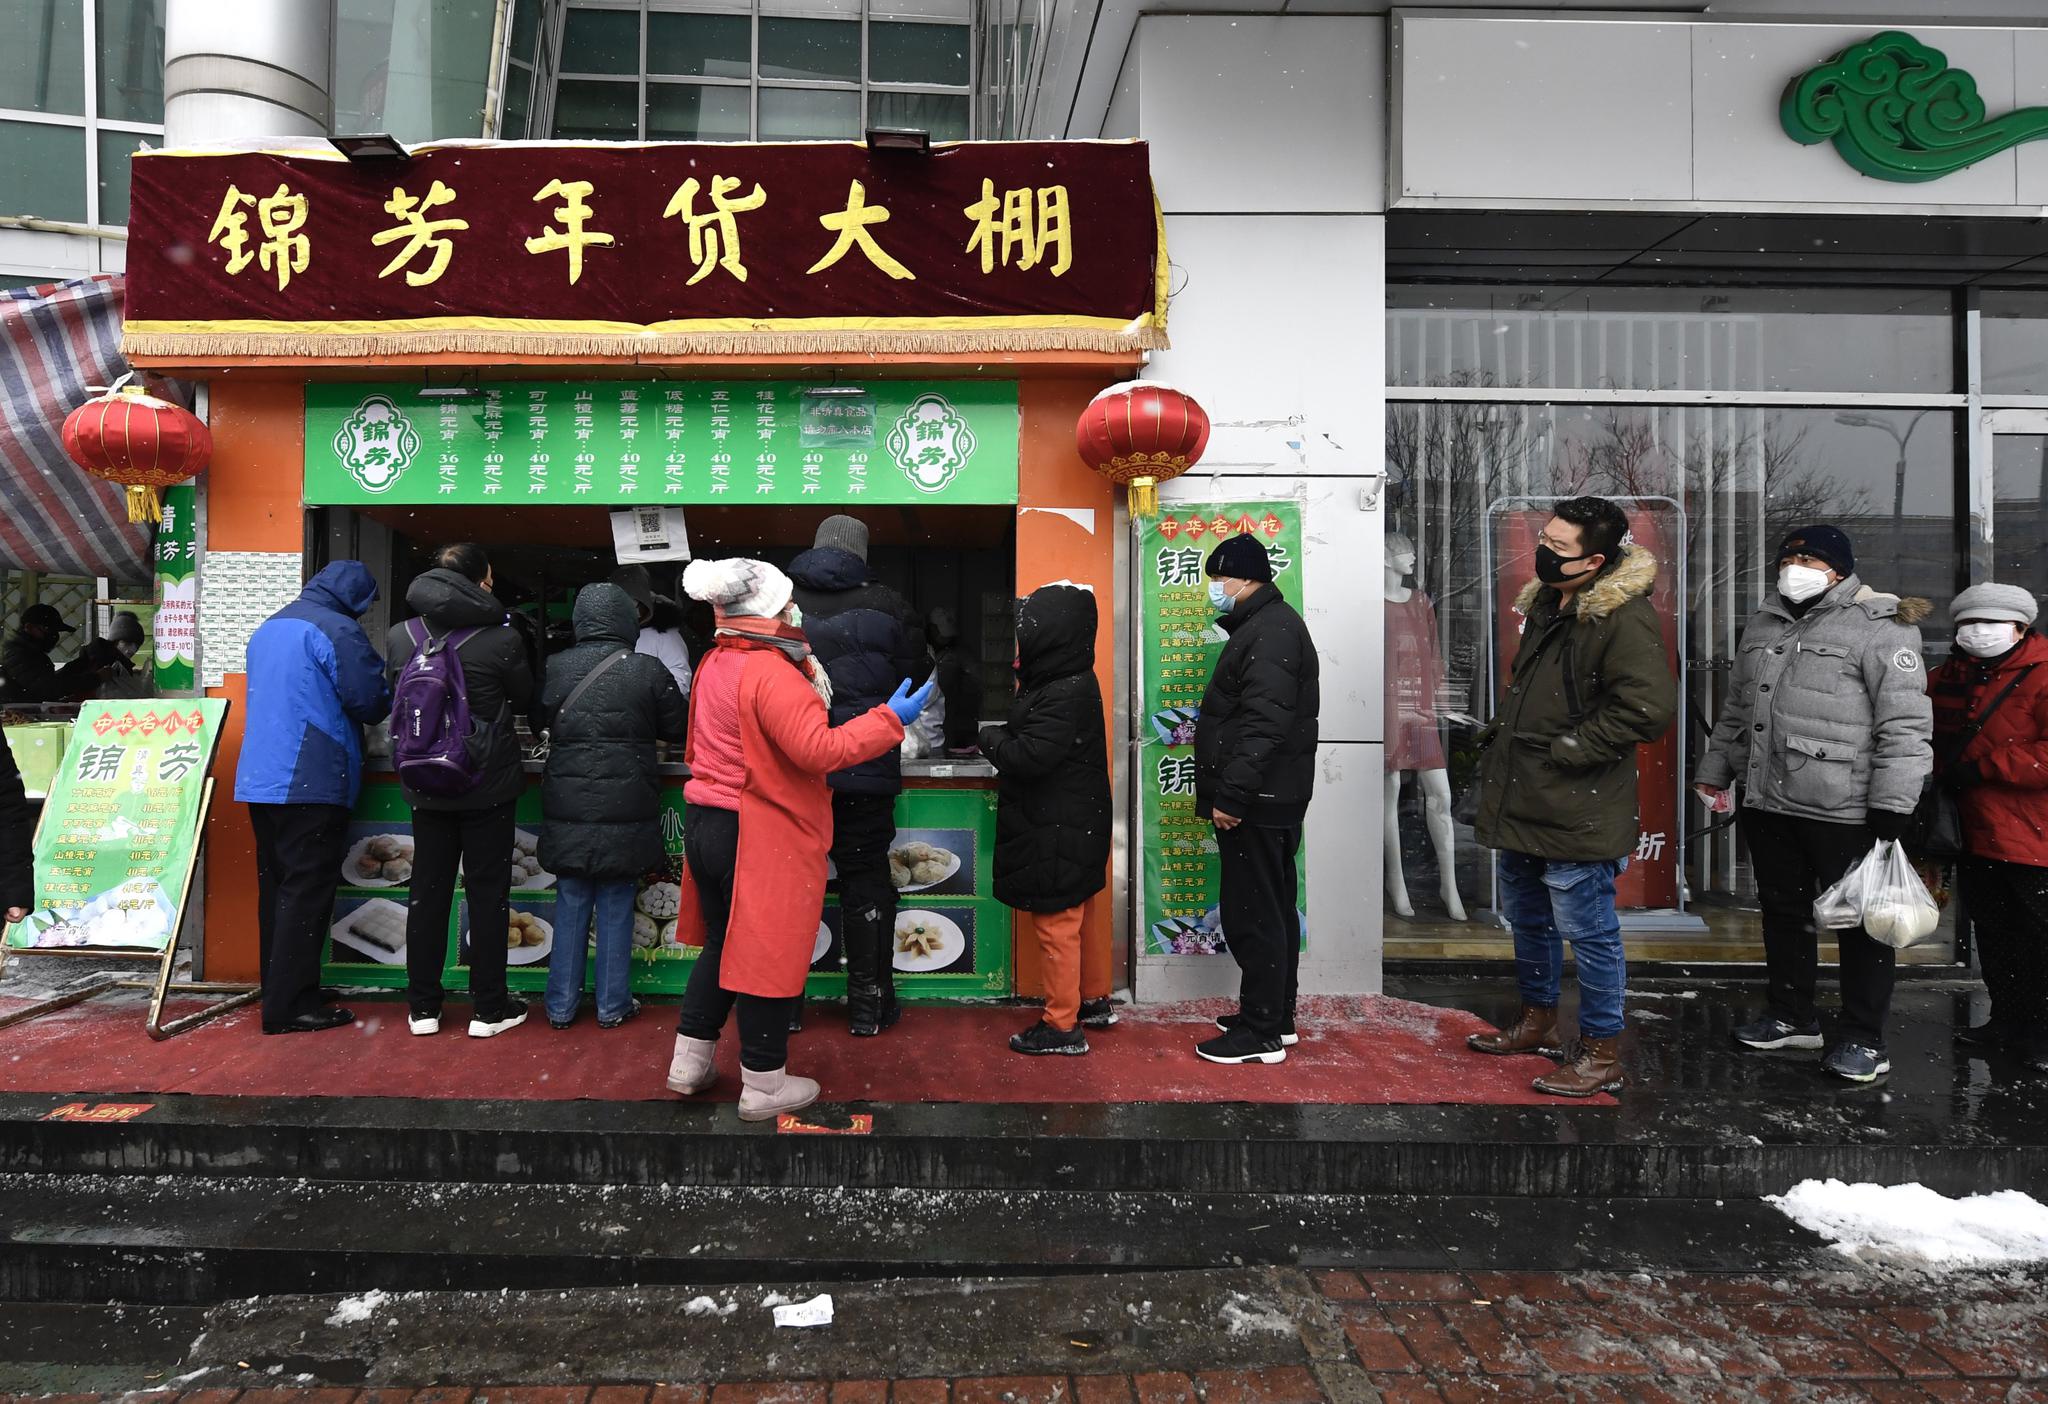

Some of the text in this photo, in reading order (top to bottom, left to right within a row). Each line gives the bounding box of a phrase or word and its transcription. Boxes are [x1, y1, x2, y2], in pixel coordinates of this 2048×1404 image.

[207, 175, 1074, 291] 锦芳年货大棚
[529, 390, 548, 440] 可可元宵
[574, 390, 594, 440] 山楂元宵
[619, 390, 640, 440] 蓝莓元宵
[664, 389, 686, 440] 低糖元宵
[711, 389, 731, 440] 五仁元宵
[756, 389, 776, 440] 桂花元宵
[1159, 518, 1280, 536] 中华名小吃
[1159, 592, 1205, 602] 什锦元宵
[1159, 607, 1217, 617] 黑芝麻元宵
[1159, 622, 1206, 633] 可可元宵
[1160, 653, 1206, 663] 山楂元宵
[1160, 668, 1207, 678] 五仁元宵
[95, 714, 203, 732] 中华名小吃
[1159, 801, 1195, 811] 什锦元
[1159, 816, 1213, 826] 黑芝麻元
[1160, 831, 1206, 841] 可可元宵
[1635, 831, 1666, 861] 折
[53, 850, 97, 860] 山楂元宵
[1161, 862, 1207, 872] 山楂元宵
[1161, 877, 1207, 887] 五仁元宵
